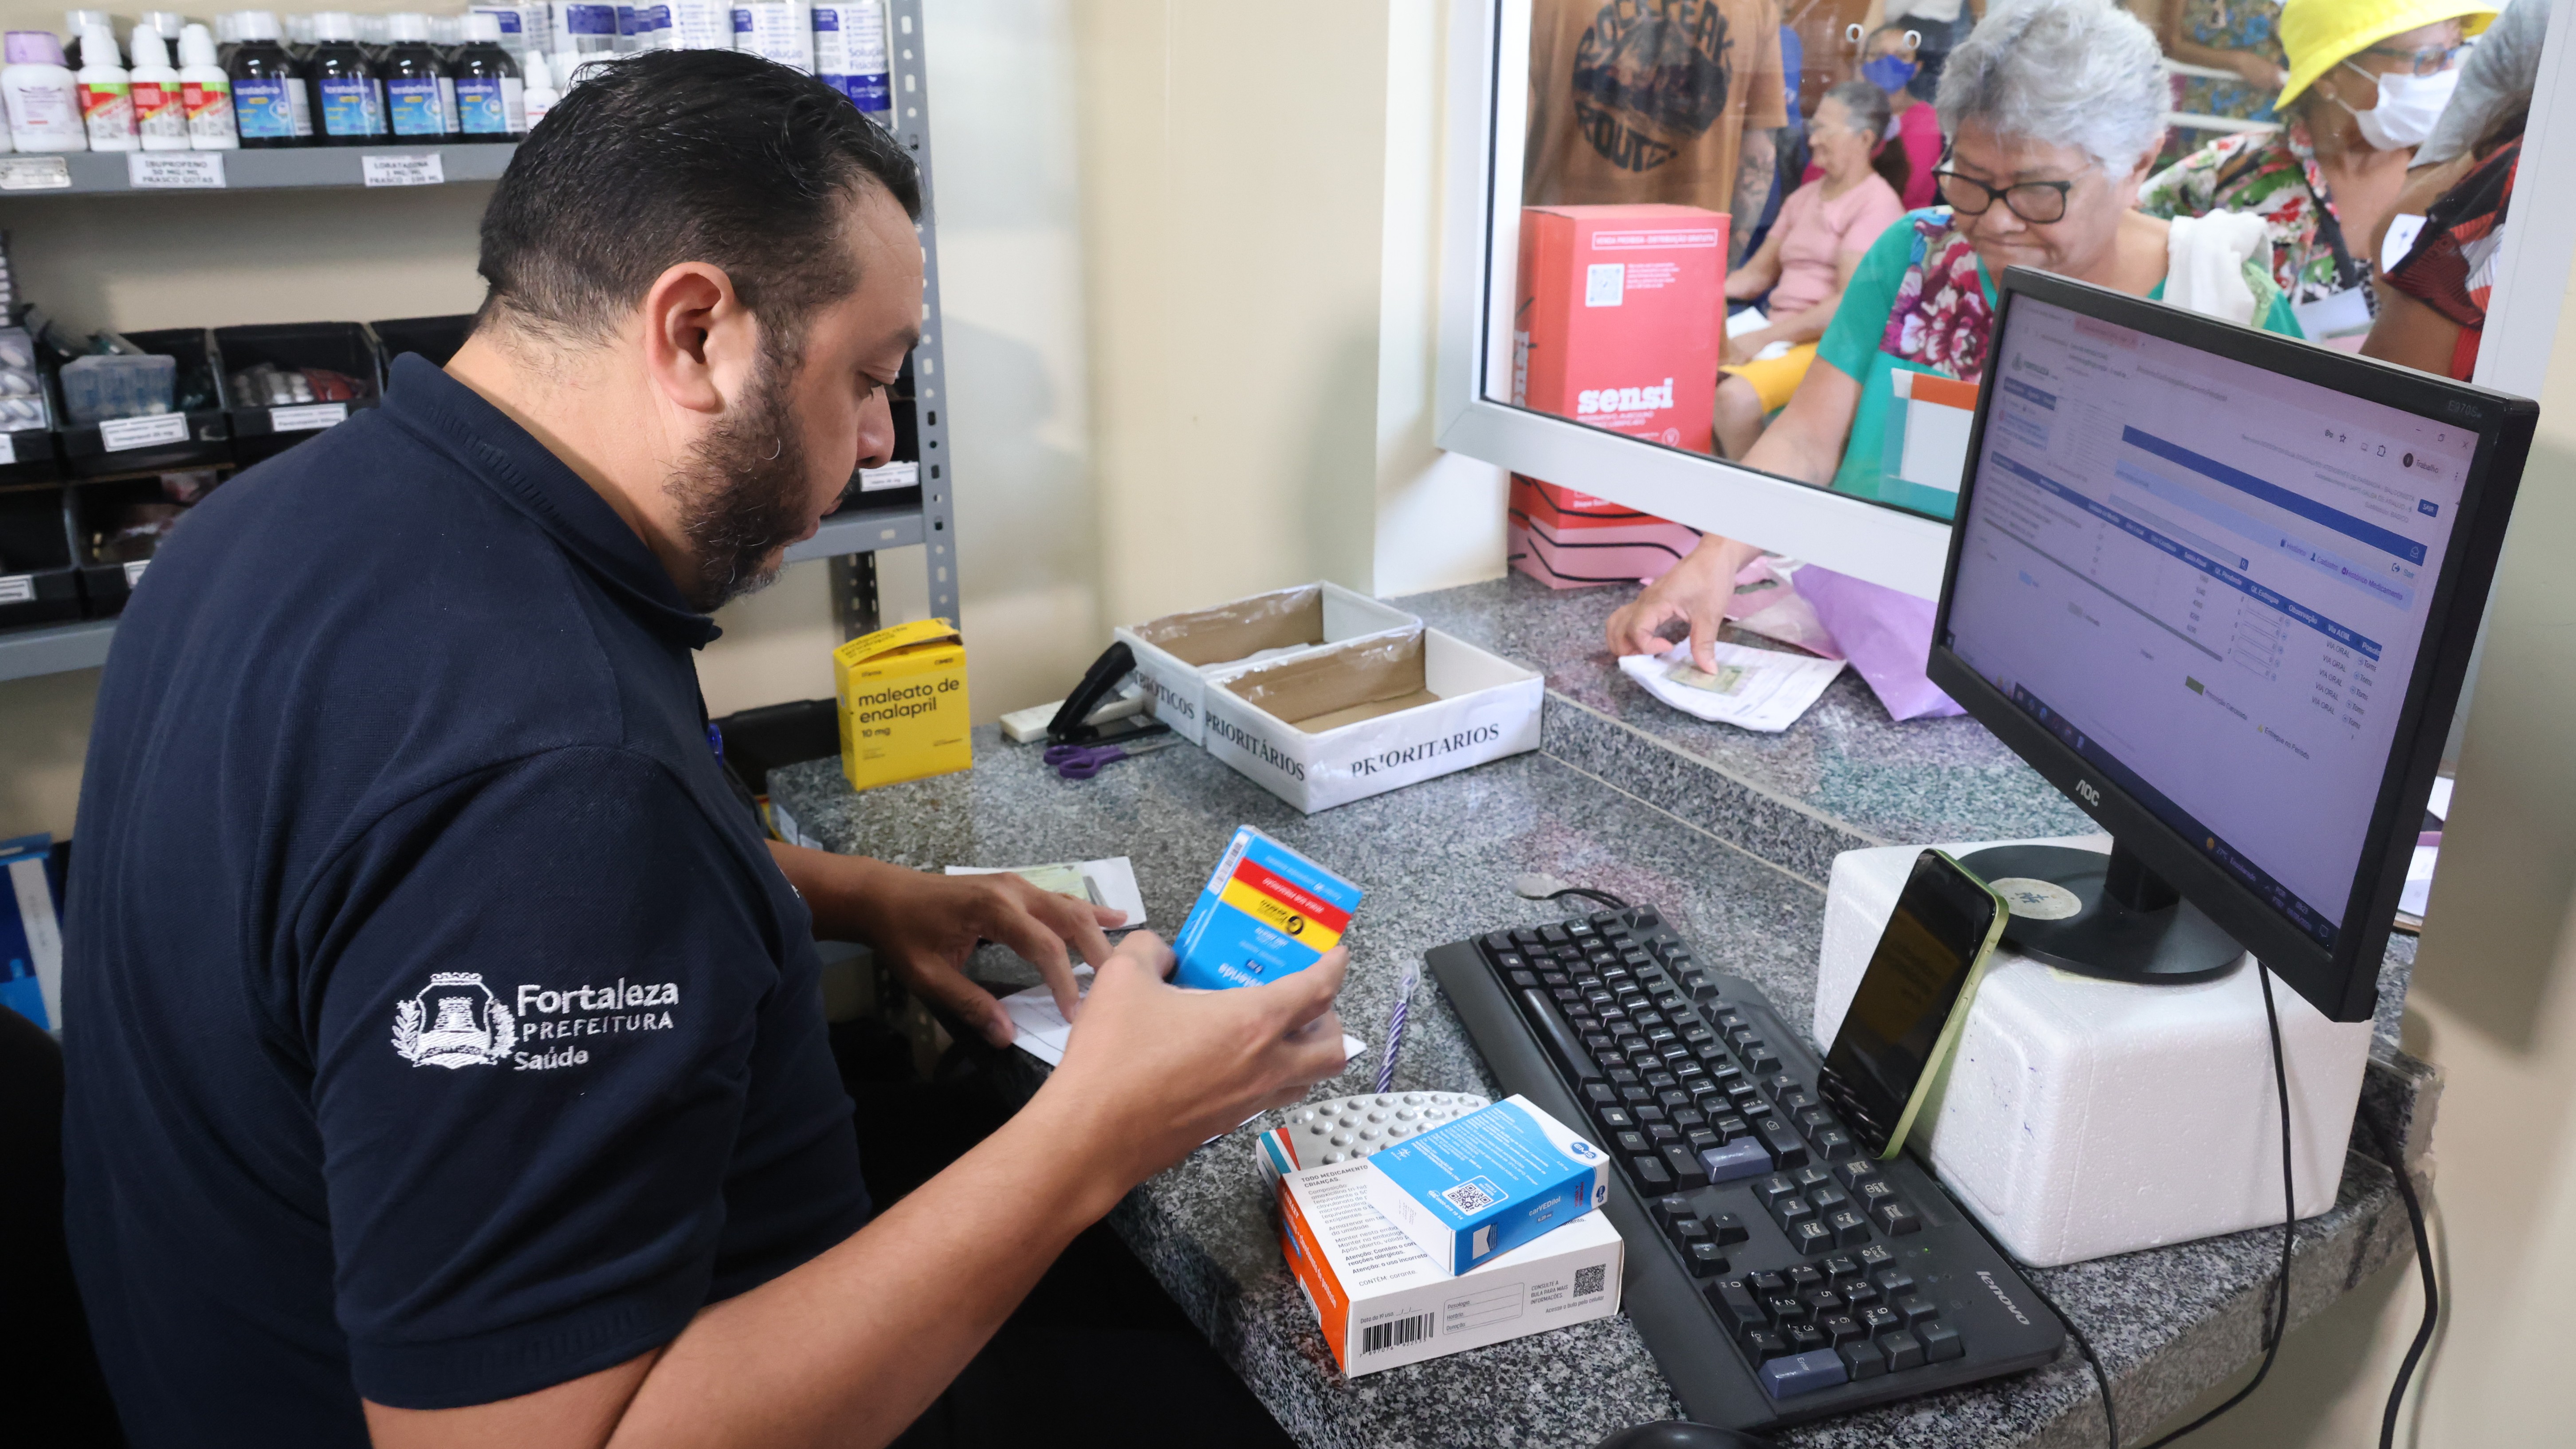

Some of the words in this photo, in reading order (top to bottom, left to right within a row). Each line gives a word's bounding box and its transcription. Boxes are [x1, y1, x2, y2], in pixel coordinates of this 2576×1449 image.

[1577, 378, 1674, 414] sensi
[2414, 458, 2440, 476] Trabalho
[2316, 554, 2339, 573] Cadastro
[2367, 578, 2403, 603] Medicamento
[2287, 602, 2318, 628] Observação
[2327, 622, 2337, 636] Via
[2325, 639, 2336, 652] VIA
[2334, 644, 2351, 660] ORAL
[2321, 653, 2332, 666] VIA
[2331, 658, 2348, 675] ORAL
[2318, 667, 2329, 680] VIA
[2327, 672, 2344, 689] ORAL
[859, 685, 933, 707] maleato
[938, 678, 959, 693] de
[2314, 681, 2325, 694] VIA
[2323, 686, 2340, 703] ORAL
[860, 697, 937, 723] enalapril
[2311, 695, 2321, 708] VIA
[2320, 700, 2336, 717] ORAL
[862, 729, 873, 738] 10
[875, 727, 891, 736] mg
[1205, 710, 1306, 781] PRIORITÁRIOS
[2263, 725, 2284, 747] Entregue
[2284, 738, 2292, 750] no
[2290, 742, 2310, 762] Período
[2076, 779, 2100, 807] AOC
[517, 977, 679, 1017] Fortaleza
[523, 1010, 674, 1042] PREFEITURA
[514, 1046, 589, 1071] Saúde
[1574, 1143, 1594, 1158] EMS
[1301, 1174, 1319, 1183] TODO
[1320, 1165, 1368, 1179] MEDICAMENTO
[1304, 1177, 1341, 1187] CRIANÇAS.
[1308, 1183, 1347, 1195] Composição:
[1311, 1189, 1347, 1200] amoxicilina
[1316, 1198, 1353, 1209] clavulanato
[1319, 1200, 1367, 1214] microcristalina
[1529, 1196, 1561, 1216] carVEDilol
[1789, 1201, 1798, 1209] End
[1329, 1219, 1364, 1231] Armazenar
[1342, 1224, 1371, 1234] umidade.
[1803, 1224, 1815, 1237] Down
[1335, 1235, 1358, 1243] Manter
[1359, 1241, 1383, 1249] aberto,
[1346, 1251, 1374, 1261] Atenção:
[1374, 1245, 1398, 1254] Contém
[1348, 1257, 1374, 1267] reações
[1374, 1251, 1406, 1260] alérgicas.
[1876, 1245, 1887, 1256] Num
[1300, 1235, 1317, 1273] clavulanato
[1317, 1268, 1322, 1281] de
[1322, 1277, 1337, 1308] potássio
[1353, 1264, 1381, 1274] Atenção:
[1399, 1253, 1427, 1263] incorreto
[1359, 1275, 1389, 1286] CONTÉM:
[1390, 1270, 1418, 1279] corante.
[1532, 1281, 1554, 1291] CONSULTE
[1589, 1295, 1604, 1304] celular
[1976, 1271, 2030, 1325] lenovo
[1755, 1334, 1763, 1343] Del
[1369, 1346, 1394, 1355] 897076
[1797, 1357, 1810, 1371] Enter
